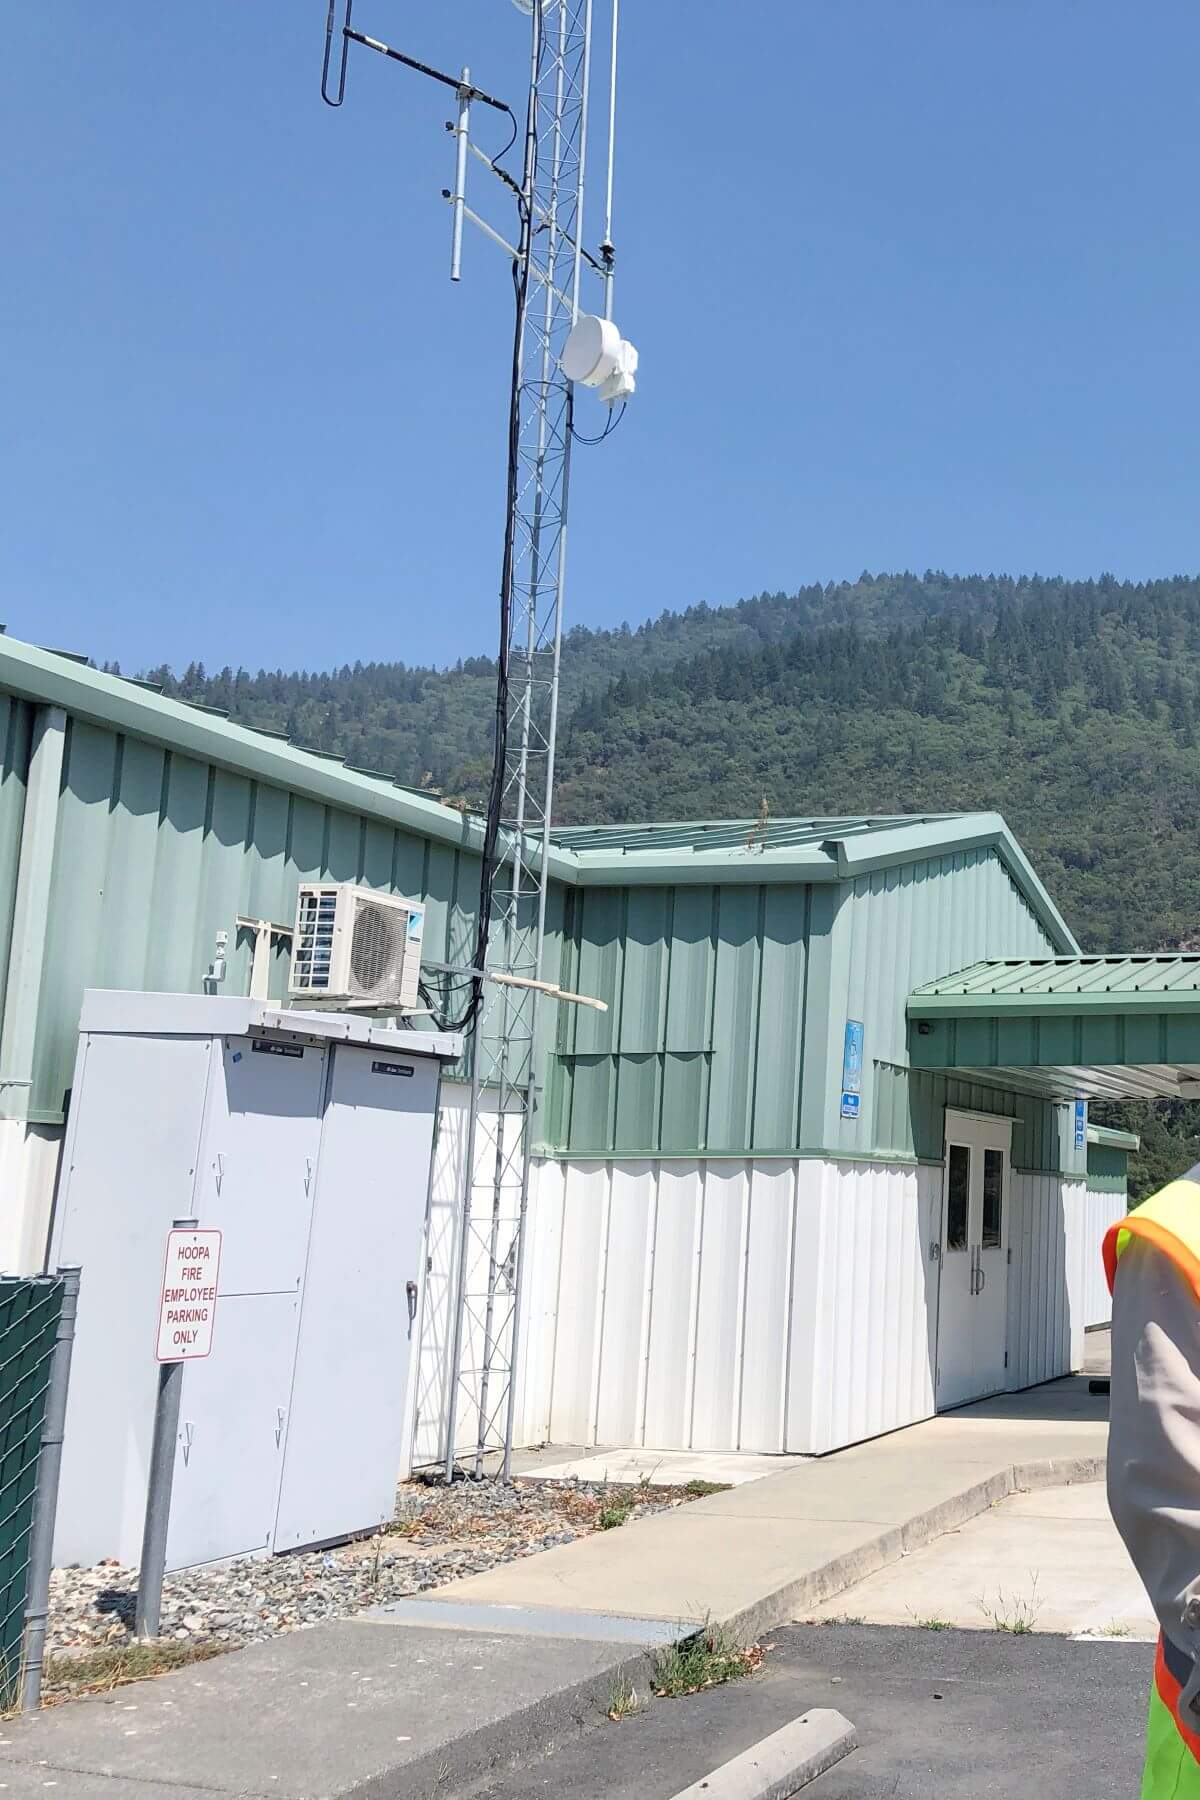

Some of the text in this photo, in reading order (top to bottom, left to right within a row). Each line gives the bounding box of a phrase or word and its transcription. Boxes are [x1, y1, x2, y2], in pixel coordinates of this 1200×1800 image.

[178, 1246, 210, 1260] HOOPA
[181, 1267, 203, 1281] FIRE
[164, 1287, 215, 1303] EMPLOYEE
[166, 1308, 208, 1324] PARKING
[173, 1330, 199, 1344] ONLY
